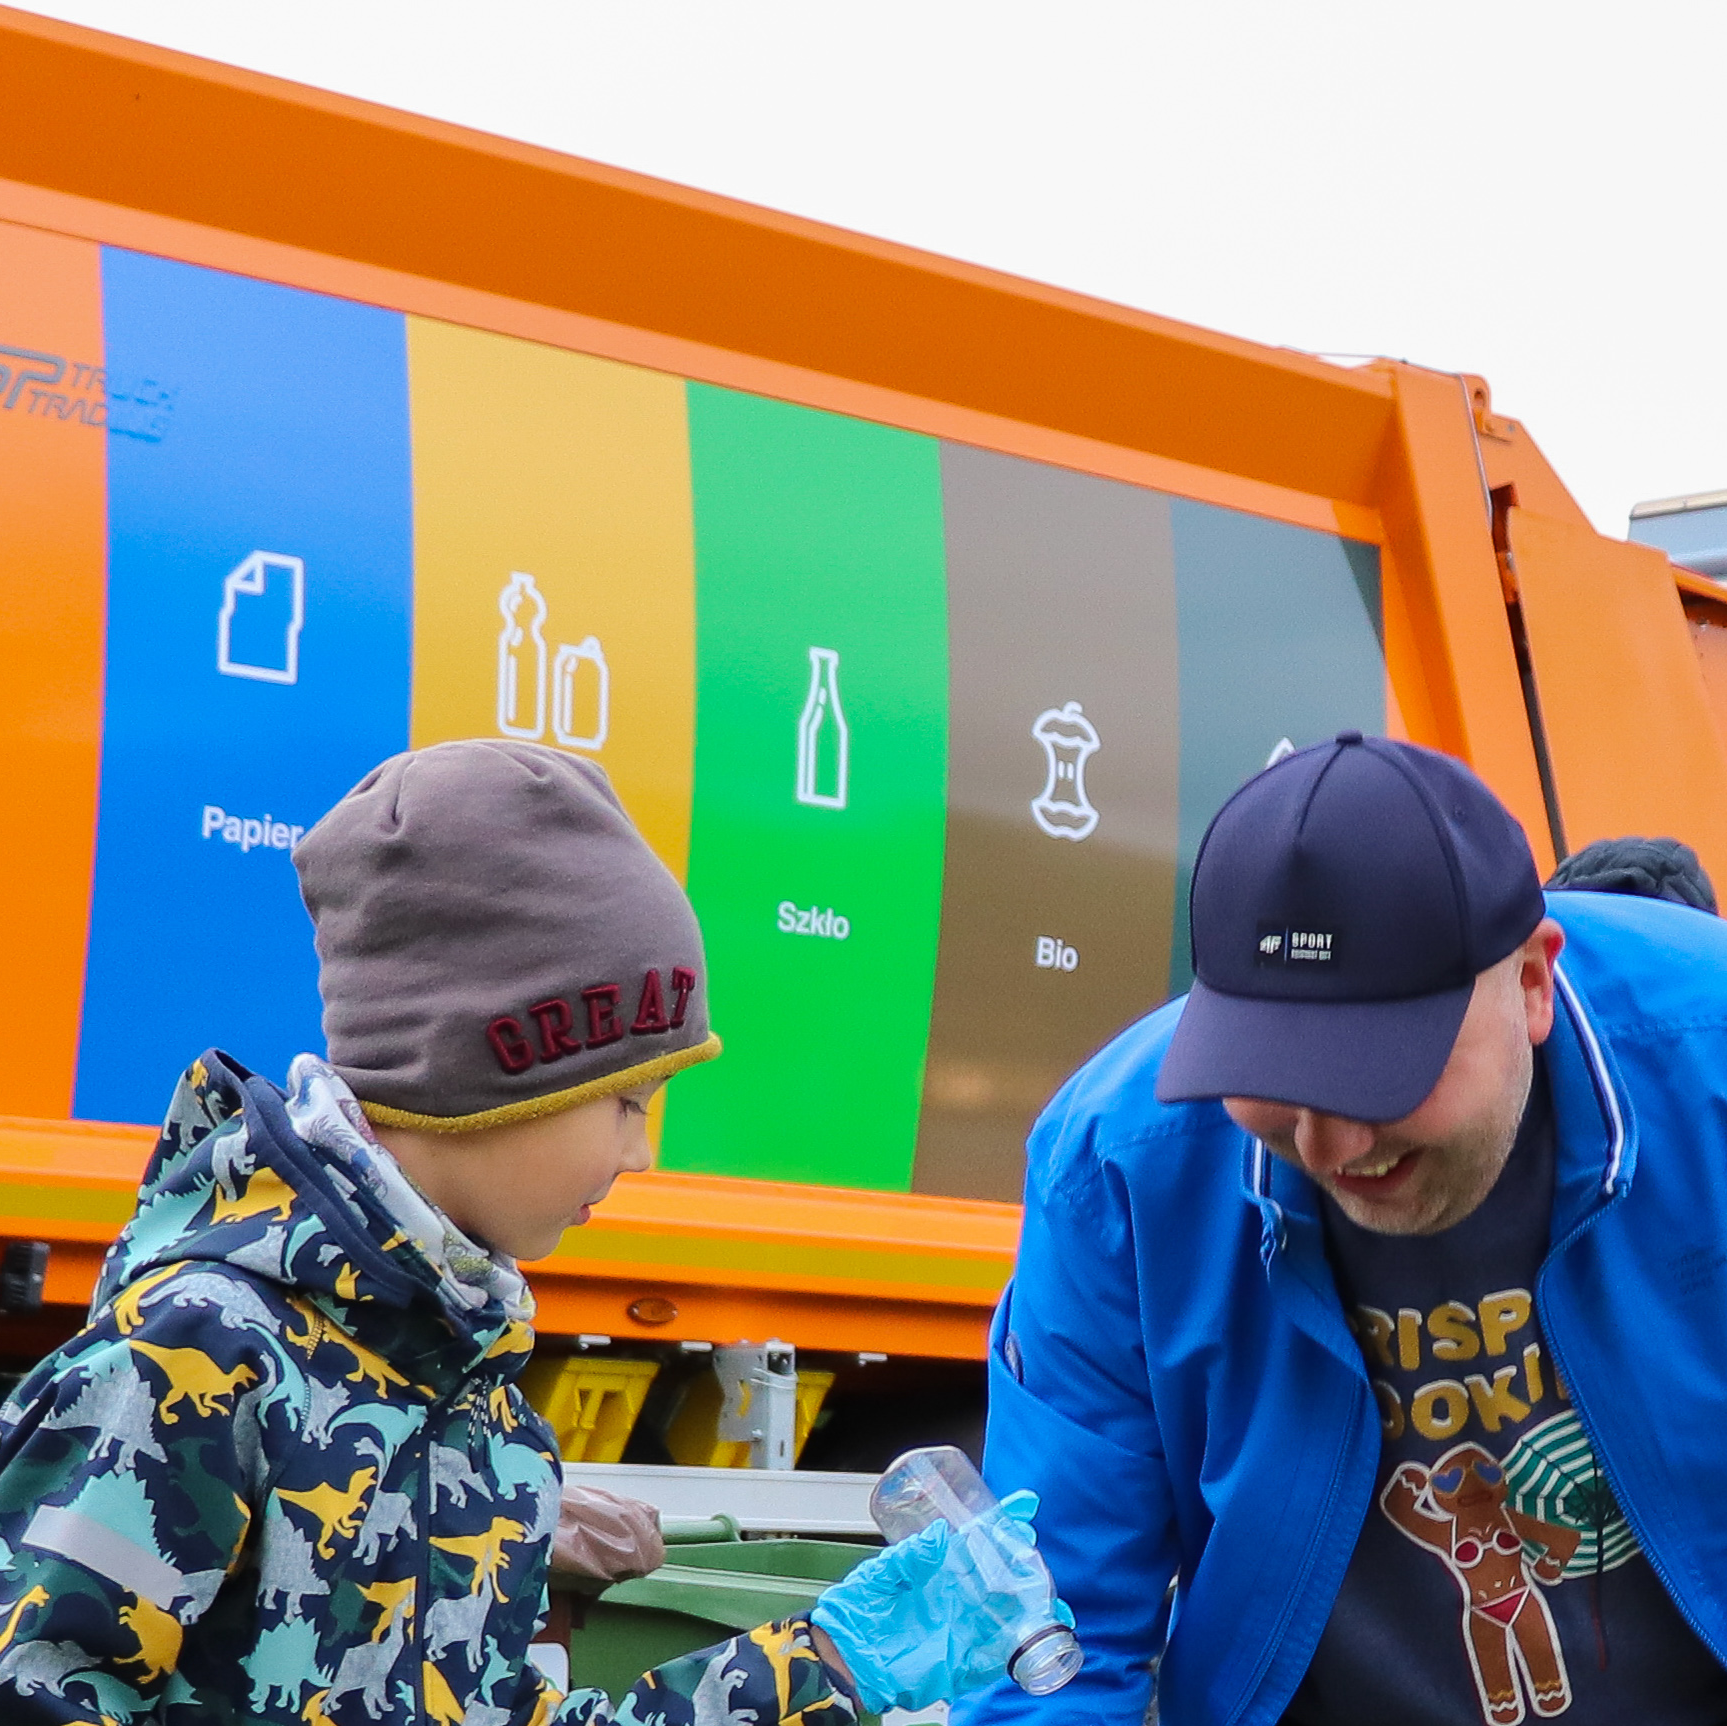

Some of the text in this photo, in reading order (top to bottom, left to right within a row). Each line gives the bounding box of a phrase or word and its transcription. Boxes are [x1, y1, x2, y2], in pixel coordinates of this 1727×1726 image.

[201, 805, 302, 856] Papier
[776, 900, 851, 941] Szkło
[1292, 931, 1333, 950] SPORT
[1035, 935, 1079, 973] Bio
[484, 966, 698, 1076] GREAT
[1356, 1287, 1532, 1372] RISP
[1380, 1342, 1570, 1441] OOKI
